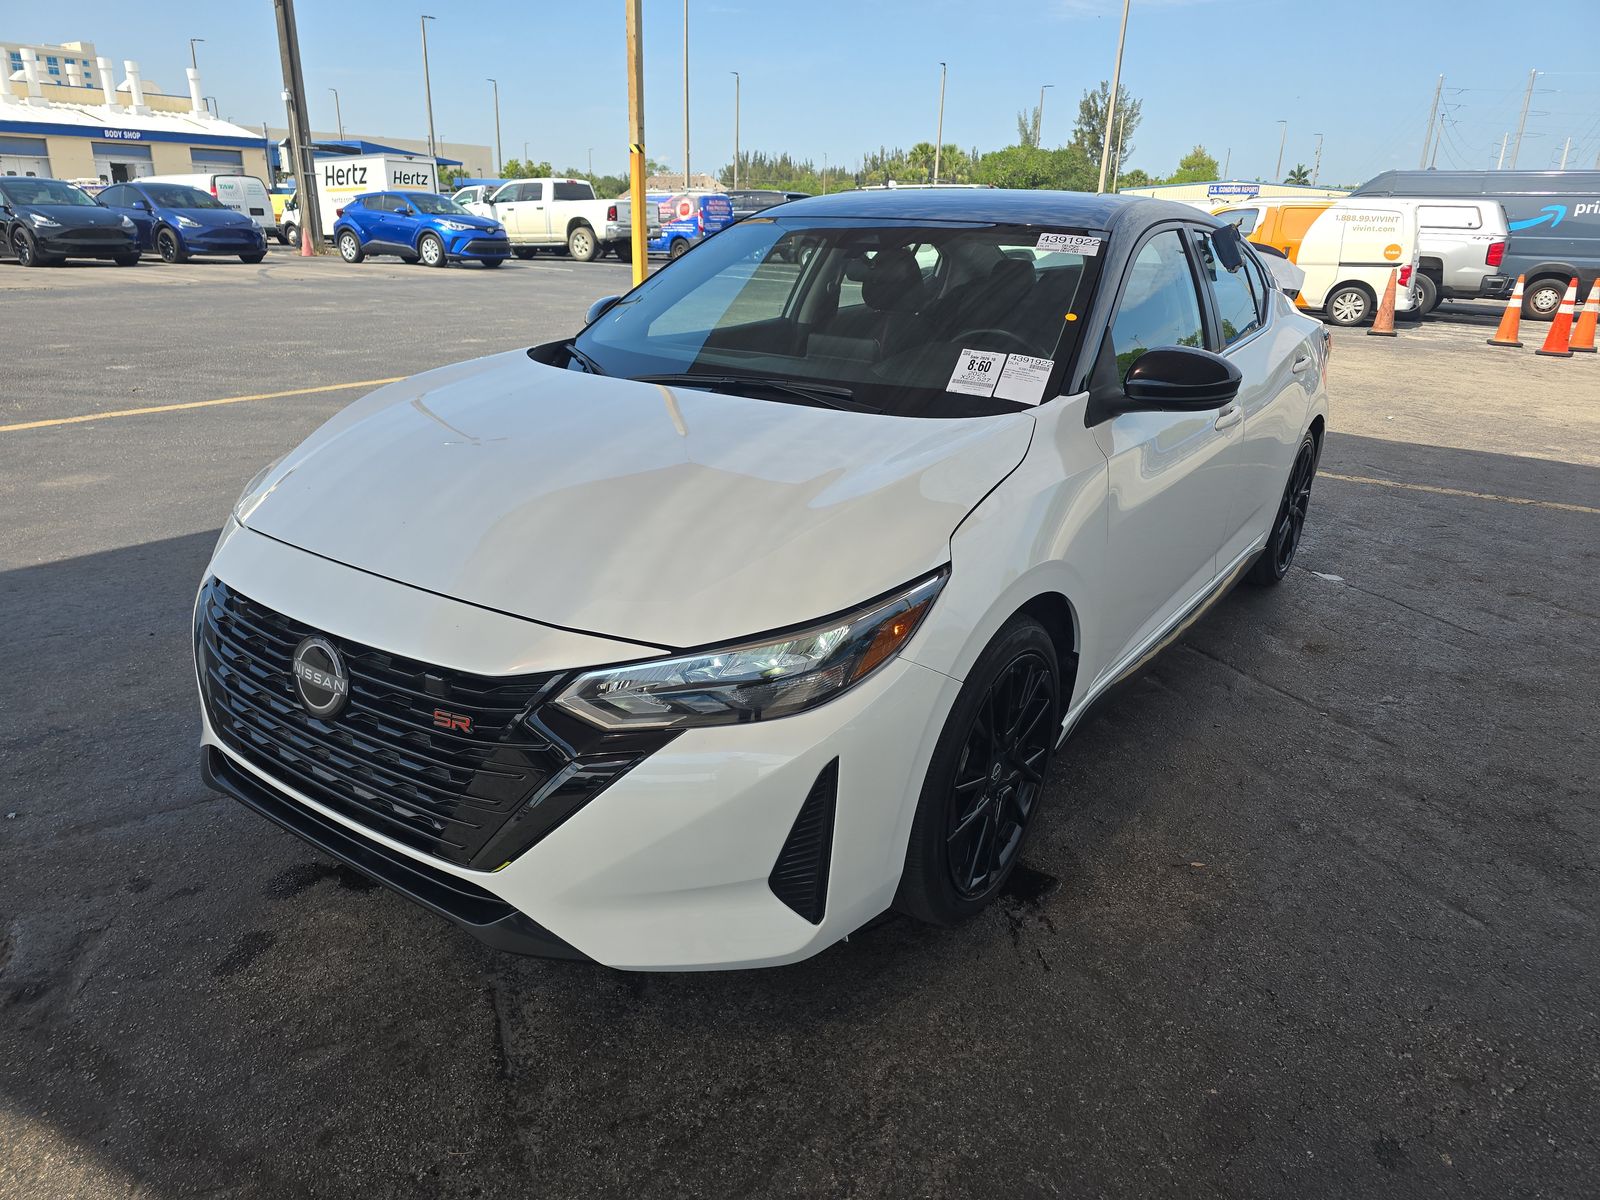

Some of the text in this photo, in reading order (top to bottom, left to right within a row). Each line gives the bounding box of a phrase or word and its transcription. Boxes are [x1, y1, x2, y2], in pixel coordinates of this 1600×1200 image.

[104, 129, 141, 139] BODY SHOP
[325, 164, 367, 186] Hertz
[393, 170, 428, 185] Hertz
[1574, 200, 1600, 217] pri
[1335, 214, 1401, 223] 1.888.99.VIVINT
[1041, 235, 1101, 246] 4391922
[967, 359, 992, 372] 8:60
[1010, 355, 1054, 367] 4391922
[294, 660, 345, 693] NISSAN
[433, 708, 473, 733] SR
